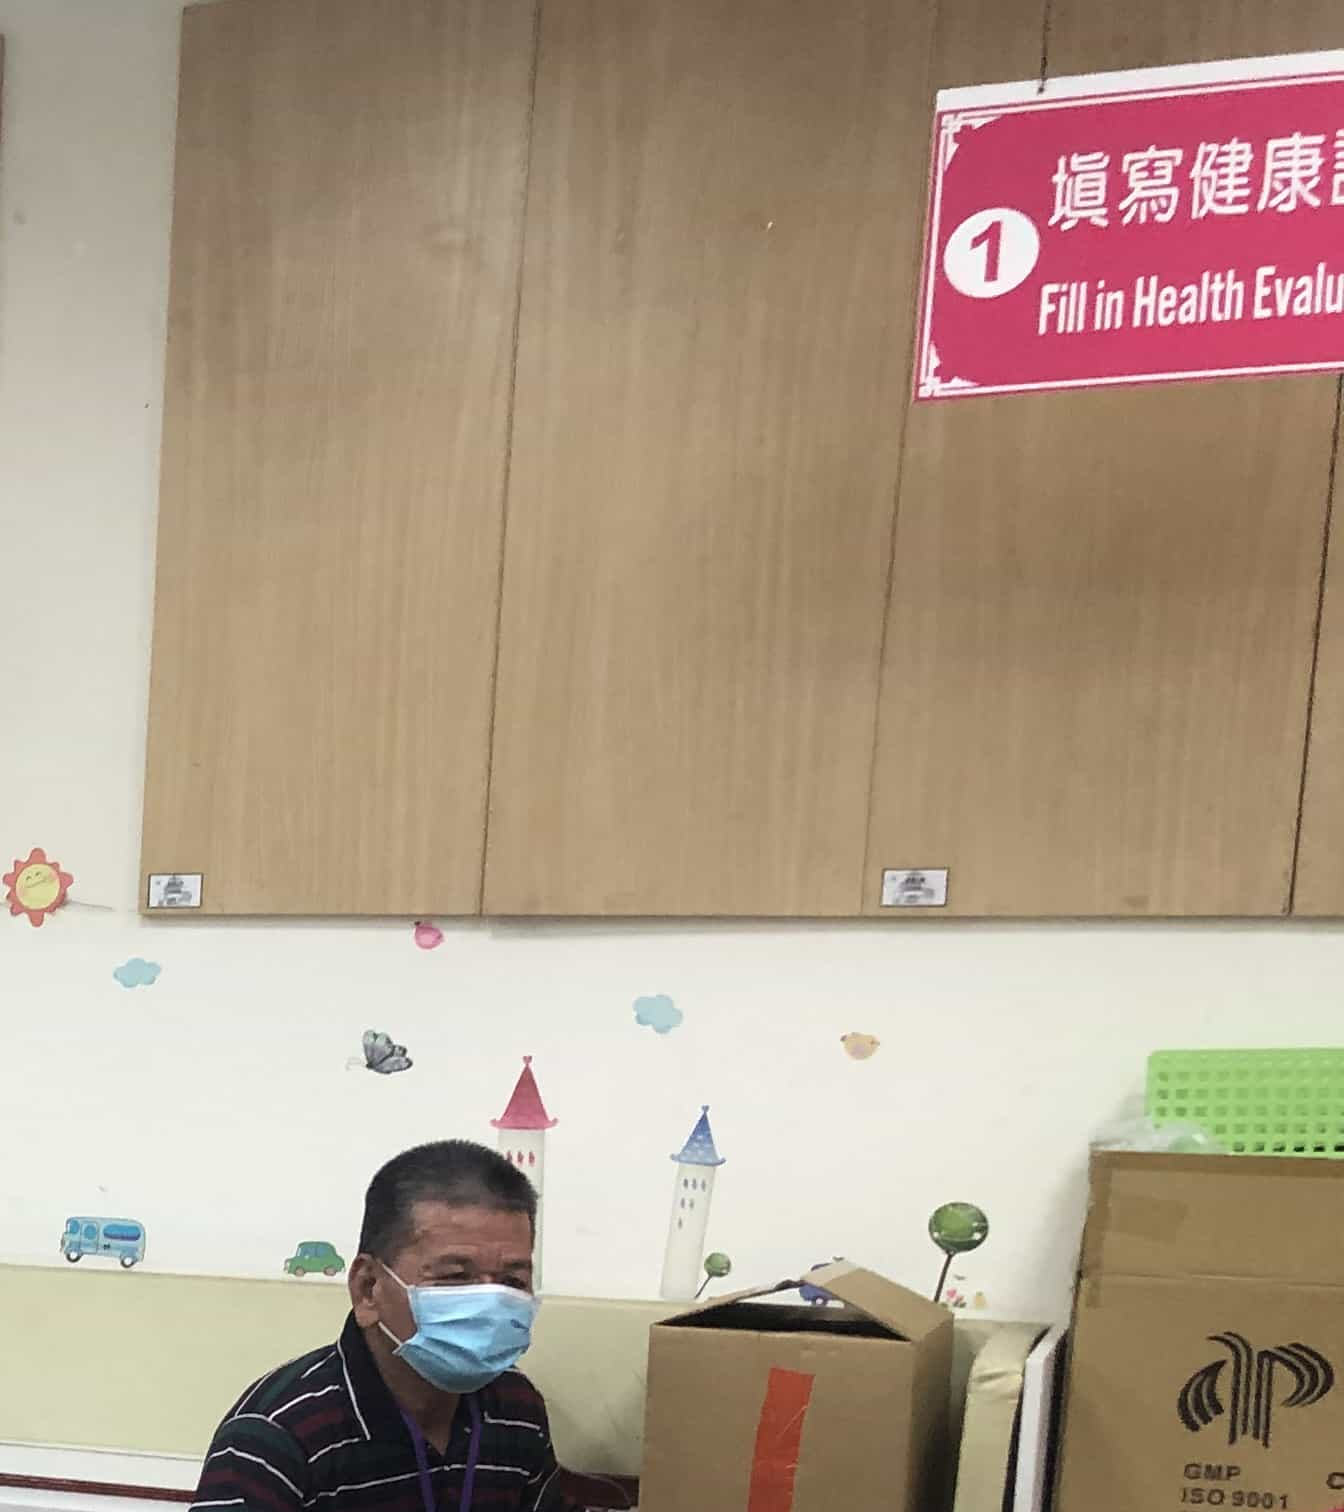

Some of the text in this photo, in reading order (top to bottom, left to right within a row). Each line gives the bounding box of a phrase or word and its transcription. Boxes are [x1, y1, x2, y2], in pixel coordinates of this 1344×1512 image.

[1047, 130, 1344, 232] 填寫健康
[1037, 261, 1344, 337] Fill in Health Evalu
[1183, 1462, 1241, 1482] GMP
[1180, 1487, 1289, 1510] ISO 9001
